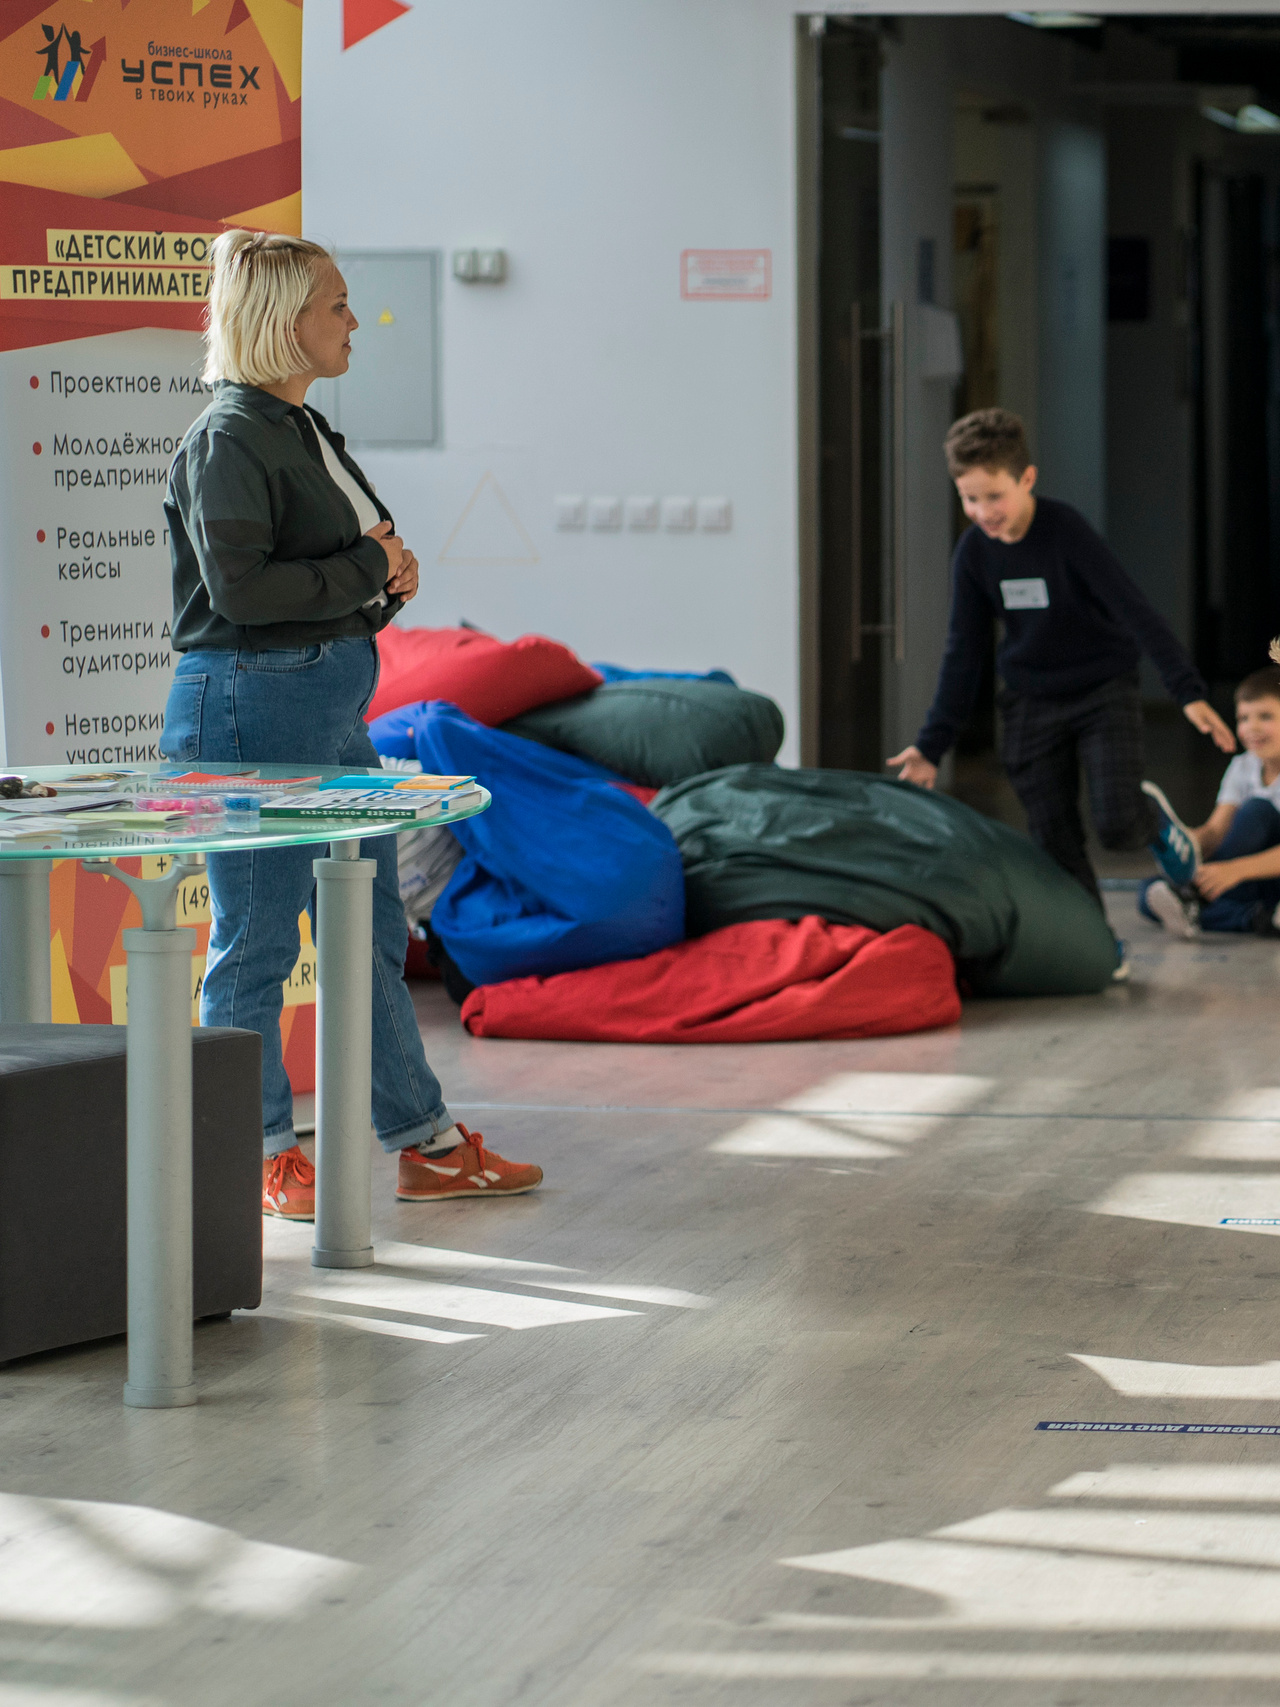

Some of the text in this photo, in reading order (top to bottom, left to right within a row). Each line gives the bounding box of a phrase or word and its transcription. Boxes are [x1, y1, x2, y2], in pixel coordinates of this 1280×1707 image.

[147, 41, 232, 60] бизнес-школа
[121, 58, 260, 90] УСПЕХ
[135, 88, 248, 110] в твоих руках
[55, 231, 215, 262] «ДЕТСКИЙ ФО
[51, 371, 161, 398] Проектное
[57, 527, 155, 549] Реальные
[58, 556, 121, 580] кейсы
[60, 620, 154, 647] Тренинги
[62, 651, 171, 678] аудитории
[176, 885, 210, 915] (49
[1047, 1422, 1184, 1433] ДИСТАНЦИЯ
